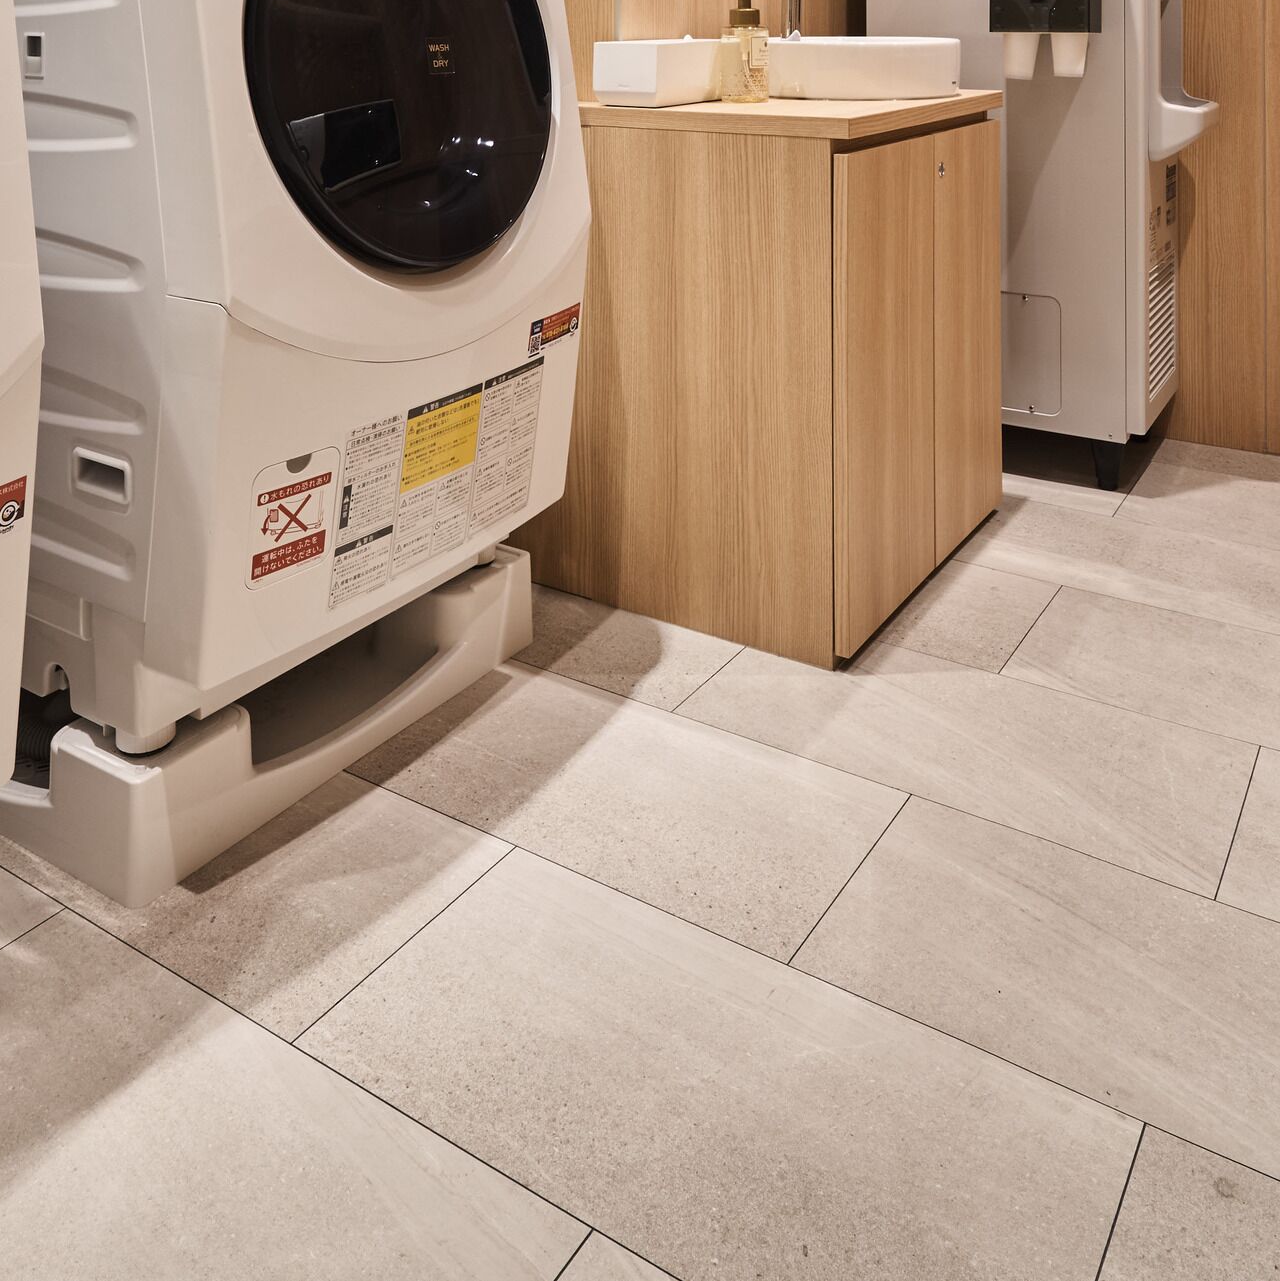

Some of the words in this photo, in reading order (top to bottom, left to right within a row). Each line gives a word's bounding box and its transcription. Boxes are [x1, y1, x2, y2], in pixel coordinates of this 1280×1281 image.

[429, 44, 449, 52] WASH
[271, 474, 329, 500] 水もれの恐れあり
[254, 547, 322, 577] 開けないでください。
[261, 536, 318, 563] 運転中は、ふたを
